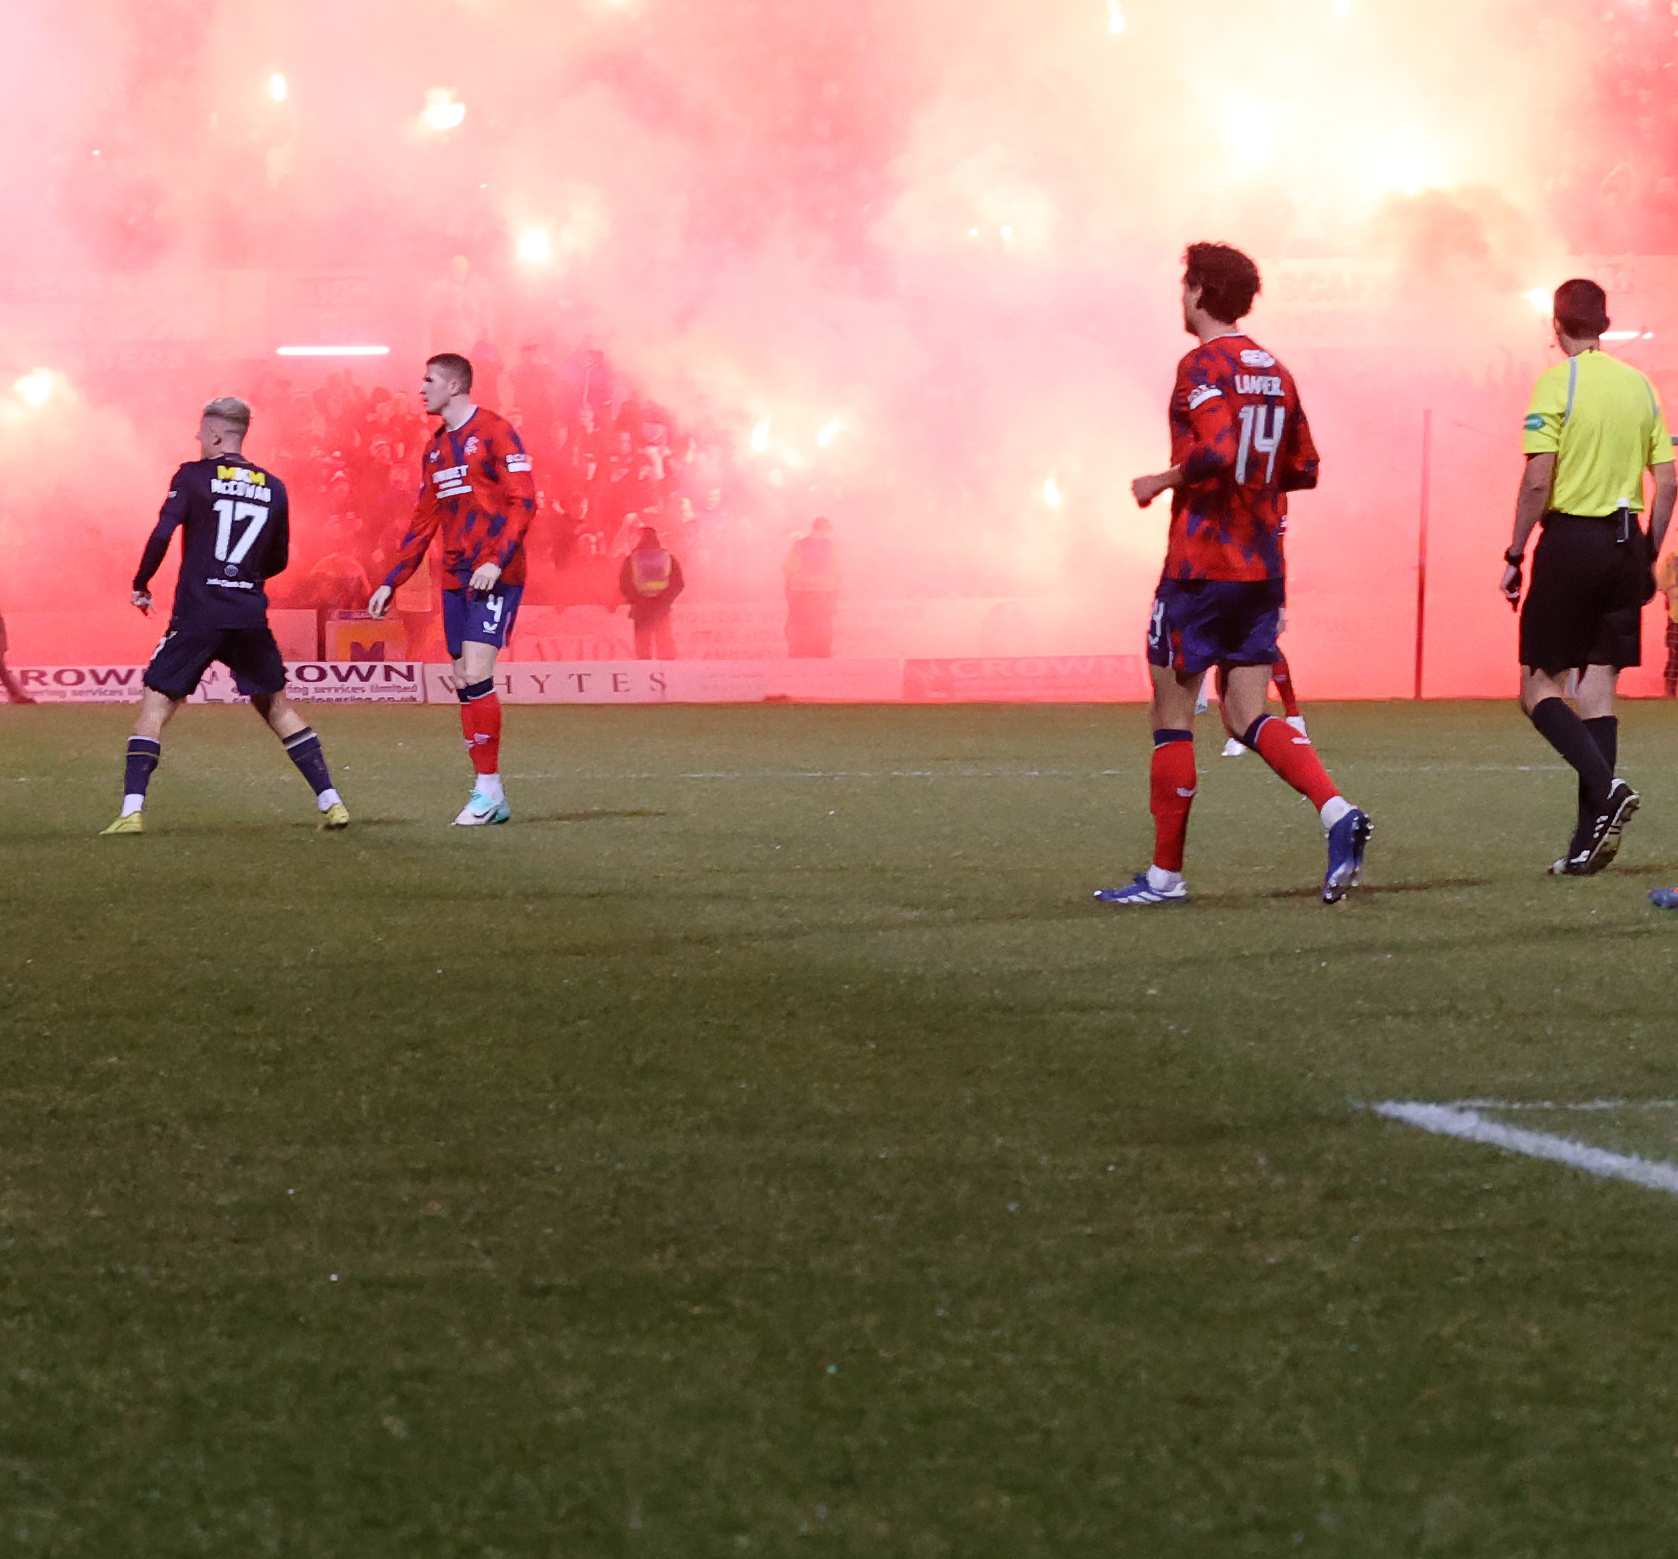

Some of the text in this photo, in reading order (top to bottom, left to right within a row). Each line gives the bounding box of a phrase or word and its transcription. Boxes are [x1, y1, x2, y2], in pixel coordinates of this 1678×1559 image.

[1235, 404, 1286, 485] 14
[217, 465, 266, 486] MKM
[212, 499, 269, 564] 17
[486, 593, 504, 623] 4
[287, 664, 415, 683] OWN
[950, 657, 1136, 677] CROWN
